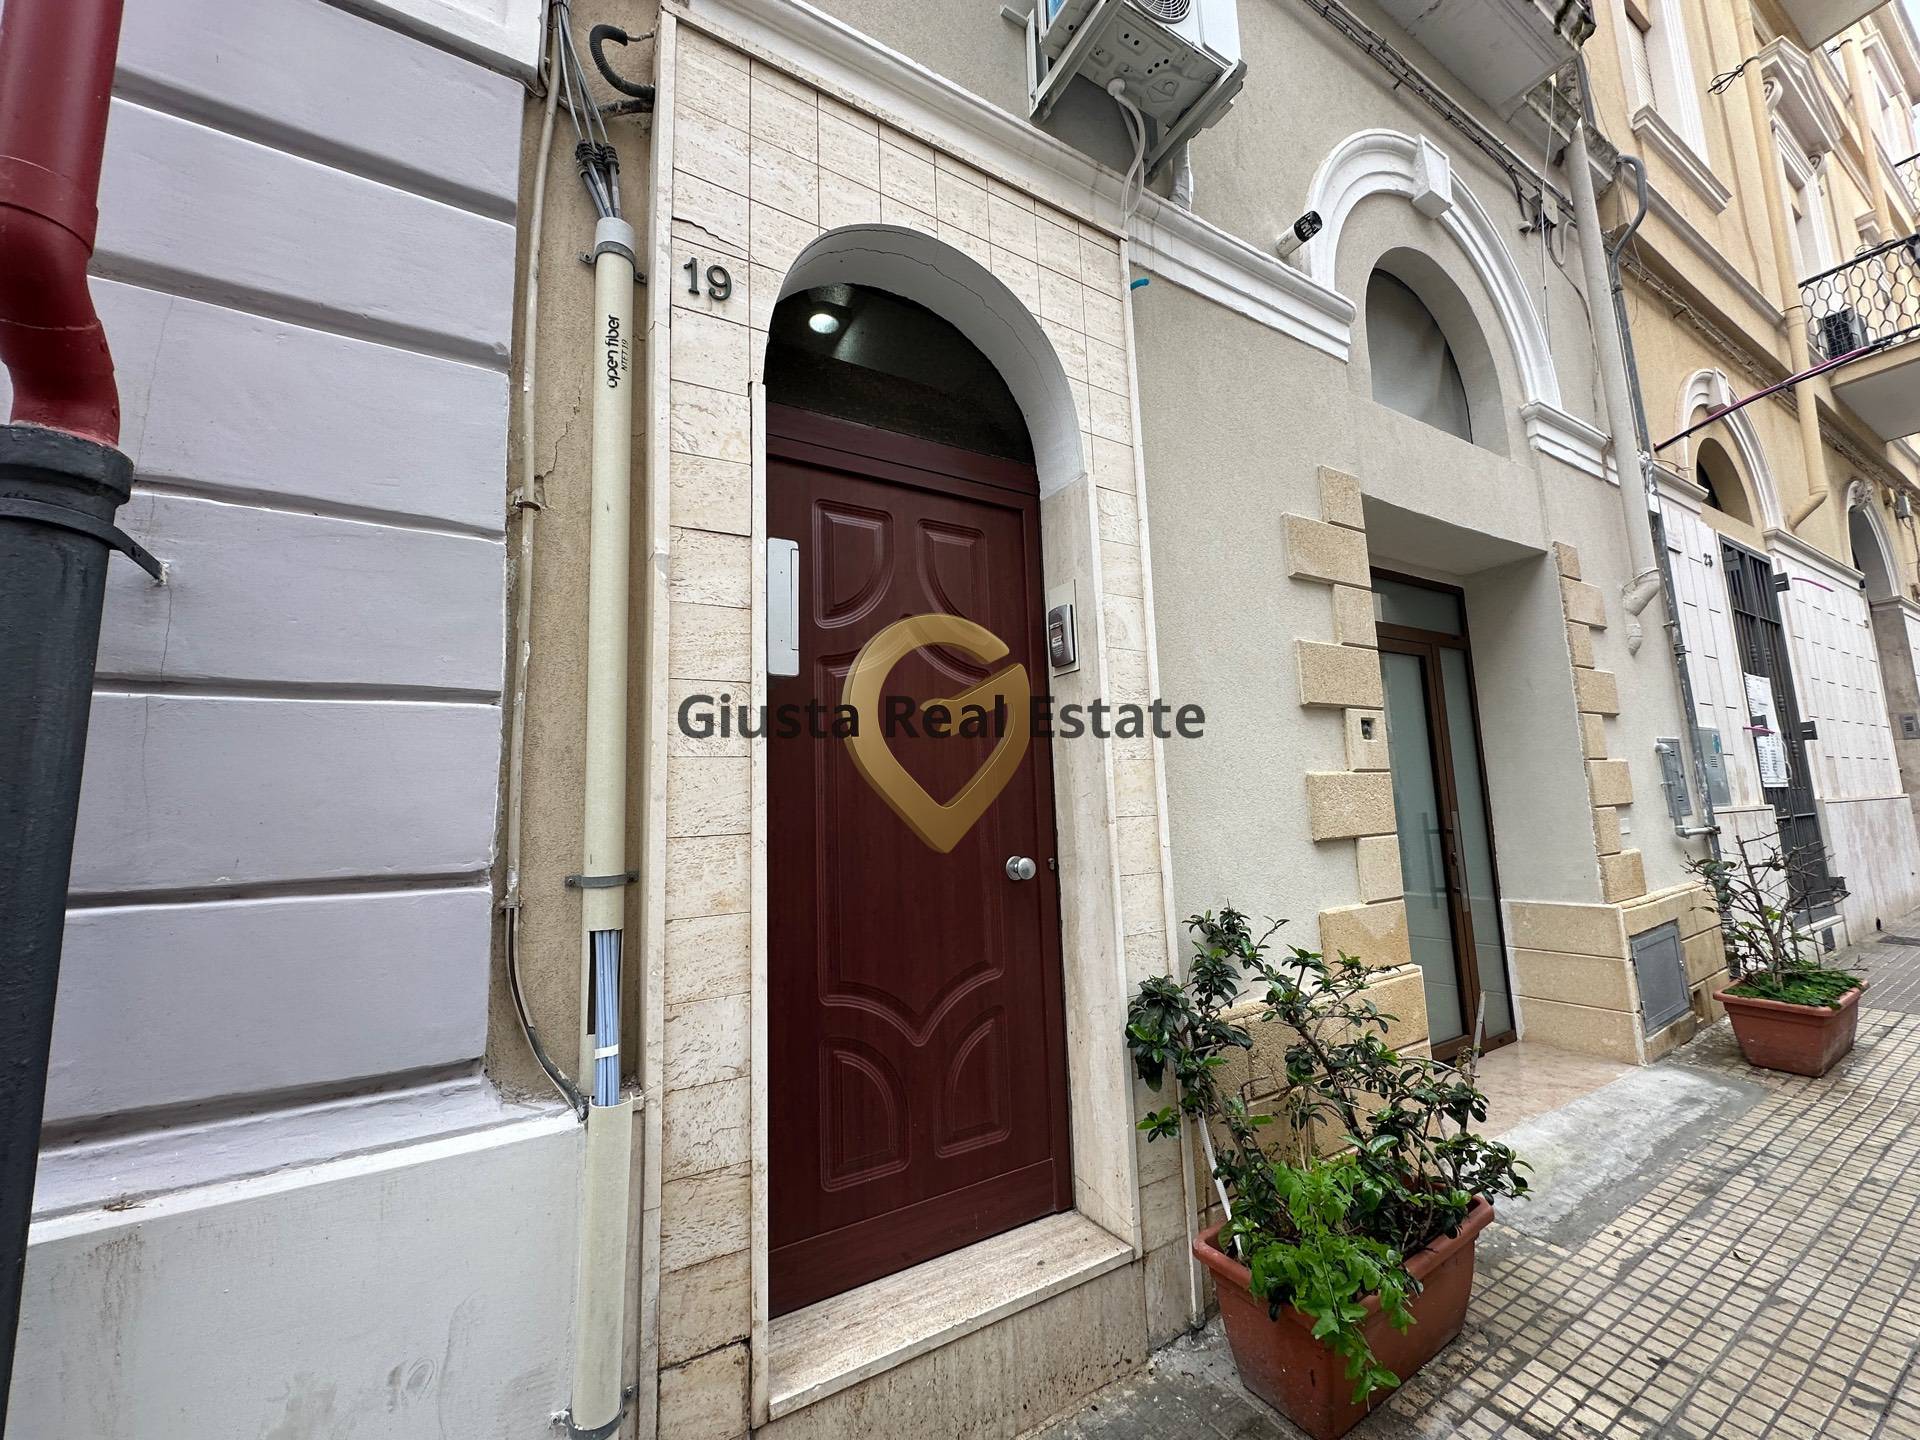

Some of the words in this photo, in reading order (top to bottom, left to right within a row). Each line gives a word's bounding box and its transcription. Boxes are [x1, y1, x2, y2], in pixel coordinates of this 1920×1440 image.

[683, 257, 732, 301] 19
[604, 314, 620, 347] fiber
[606, 350, 621, 389] open
